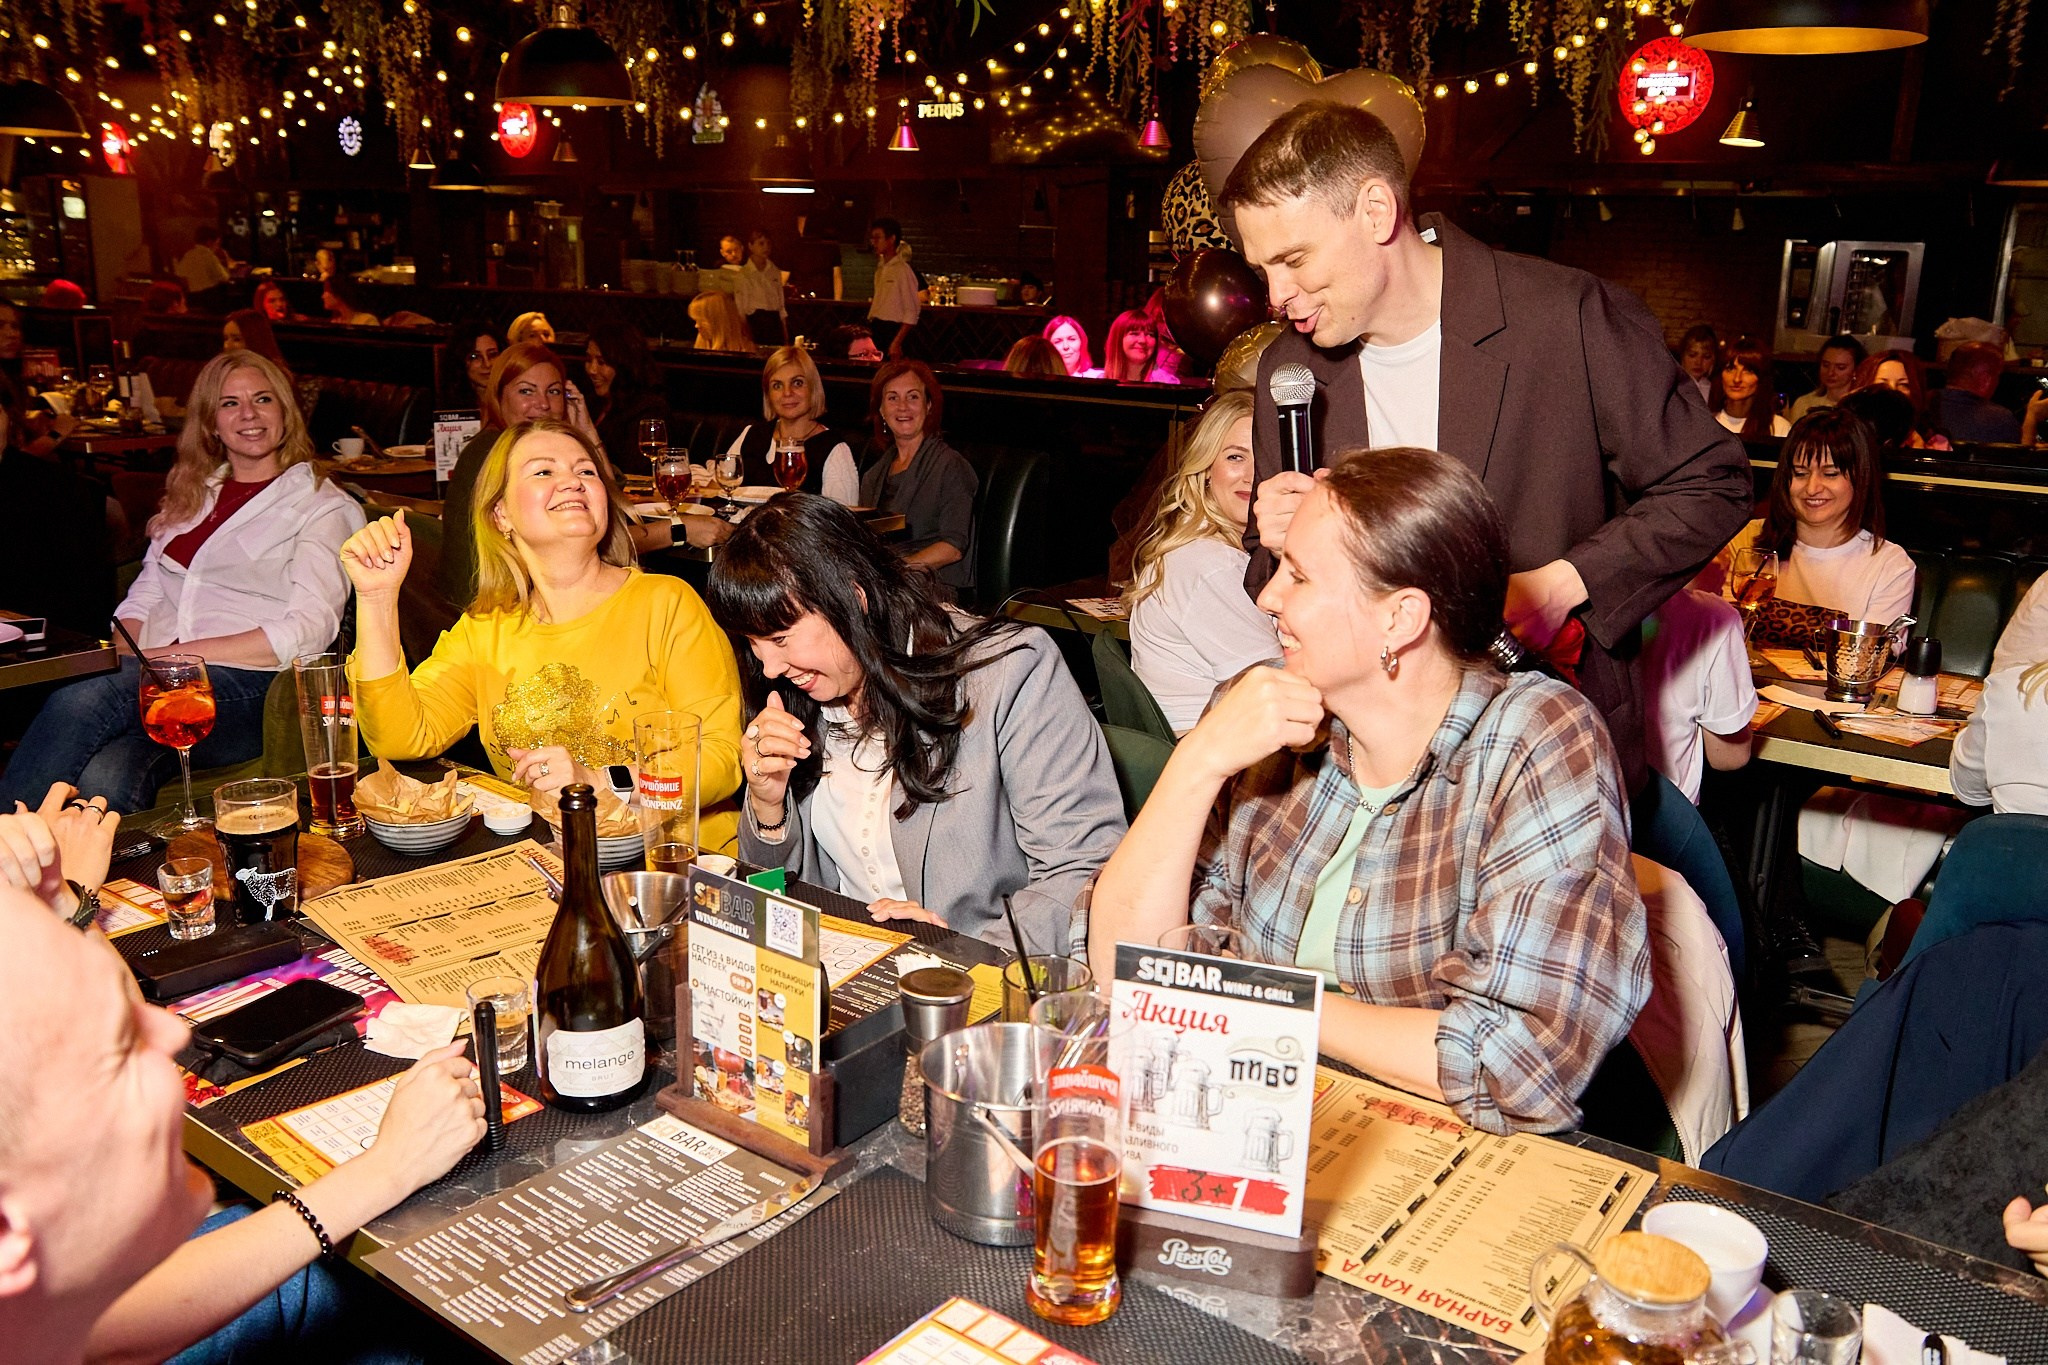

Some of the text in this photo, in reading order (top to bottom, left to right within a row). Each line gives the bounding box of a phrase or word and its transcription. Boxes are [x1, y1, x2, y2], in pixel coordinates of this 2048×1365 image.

[917, 102, 965, 120] PETRUS
[691, 943, 705, 953] СЕТ
[706, 948, 718, 959] ИЗ
[726, 956, 756, 974] ВИДОВ
[691, 953, 727, 973] НАСТОЕК
[769, 978, 805, 997] НАПИТКИ
[1222, 980, 1253, 998] WINE
[1253, 985, 1263, 999] &
[1264, 986, 1295, 1004] GRILL
[1122, 990, 1230, 1035] Акция
[565, 1049, 635, 1070] melange
[591, 1073, 615, 1082] BRUT
[1135, 1123, 1165, 1137] ВИДЫ
[1120, 1135, 1179, 1154] ЗЛИВНОГО
[1341, 1258, 1515, 1334] БАРНАЯ КАРТА
